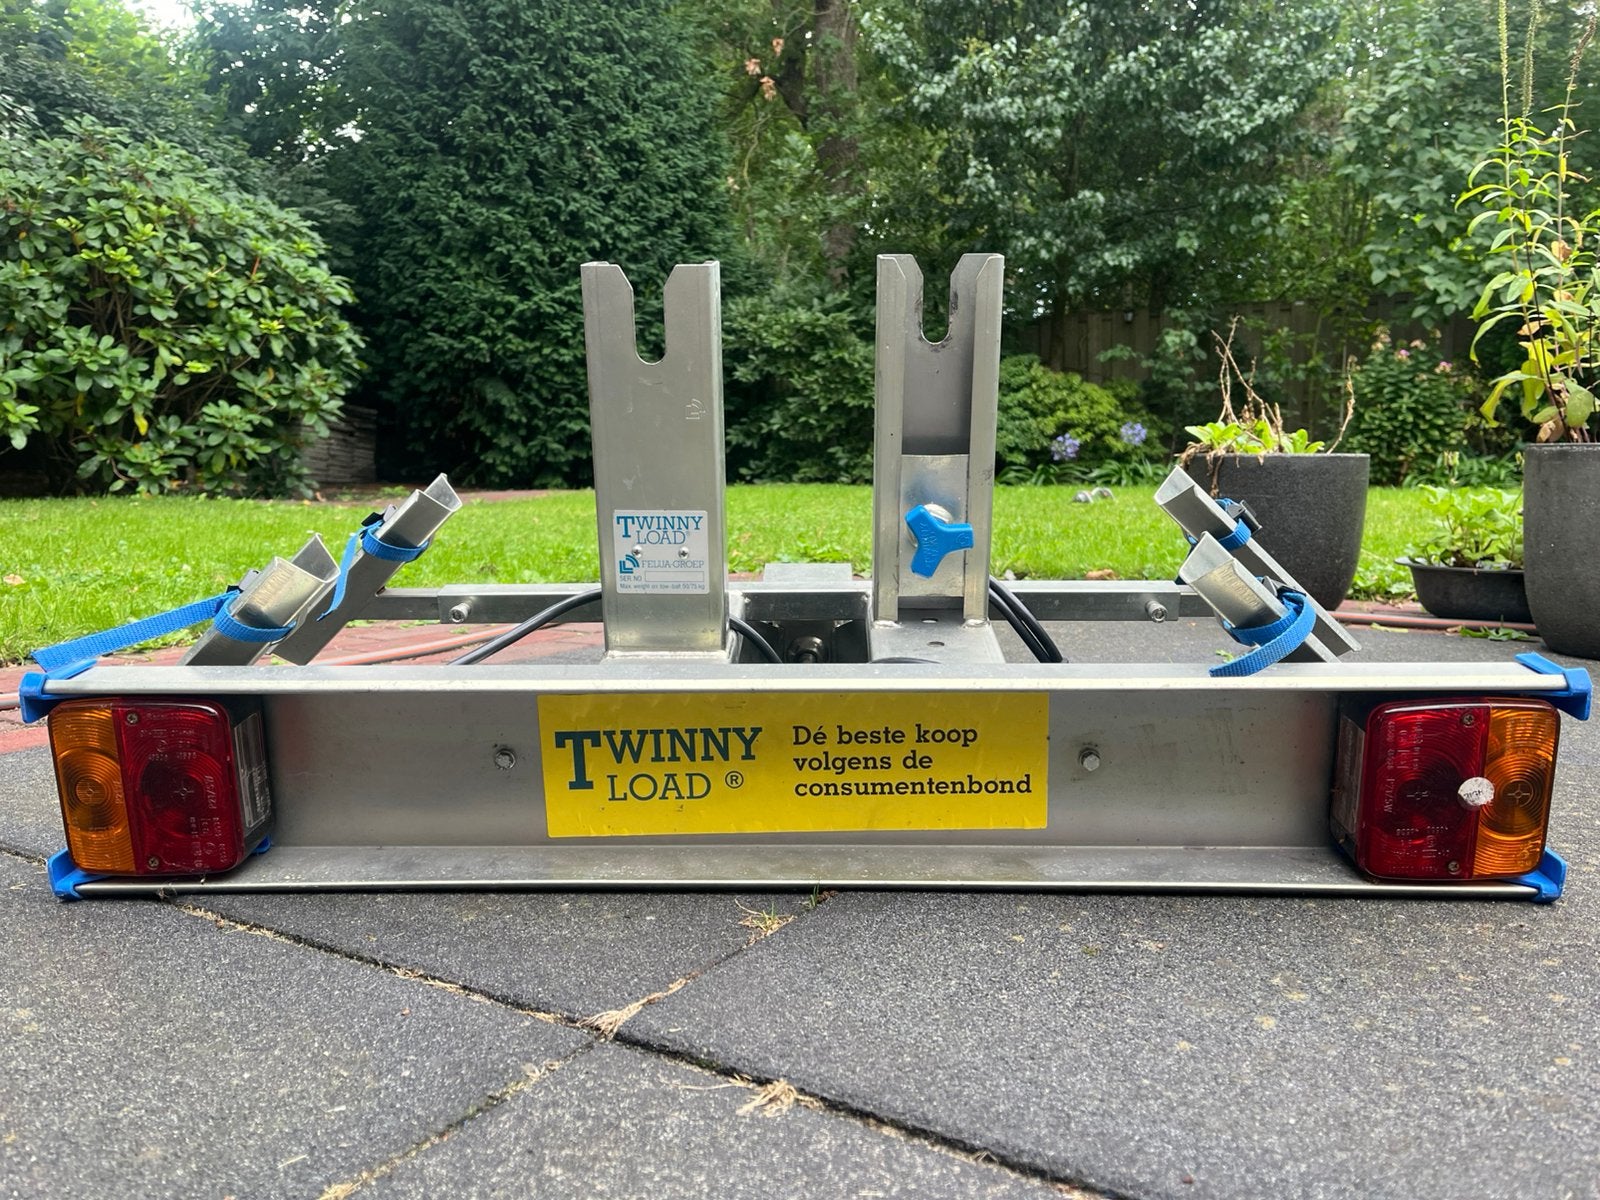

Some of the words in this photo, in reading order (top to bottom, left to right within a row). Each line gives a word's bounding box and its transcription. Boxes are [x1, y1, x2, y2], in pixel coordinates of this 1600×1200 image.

[616, 515, 703, 538] TWINNY
[636, 530, 686, 545] LOAD
[792, 725, 828, 746] Dé
[836, 725, 906, 745] beste
[915, 723, 978, 748] koop
[554, 726, 763, 790] TWINNY
[793, 751, 892, 775] volgens
[902, 749, 933, 770] de
[606, 772, 712, 801] LOAD
[794, 774, 1032, 797] consumentenbond
